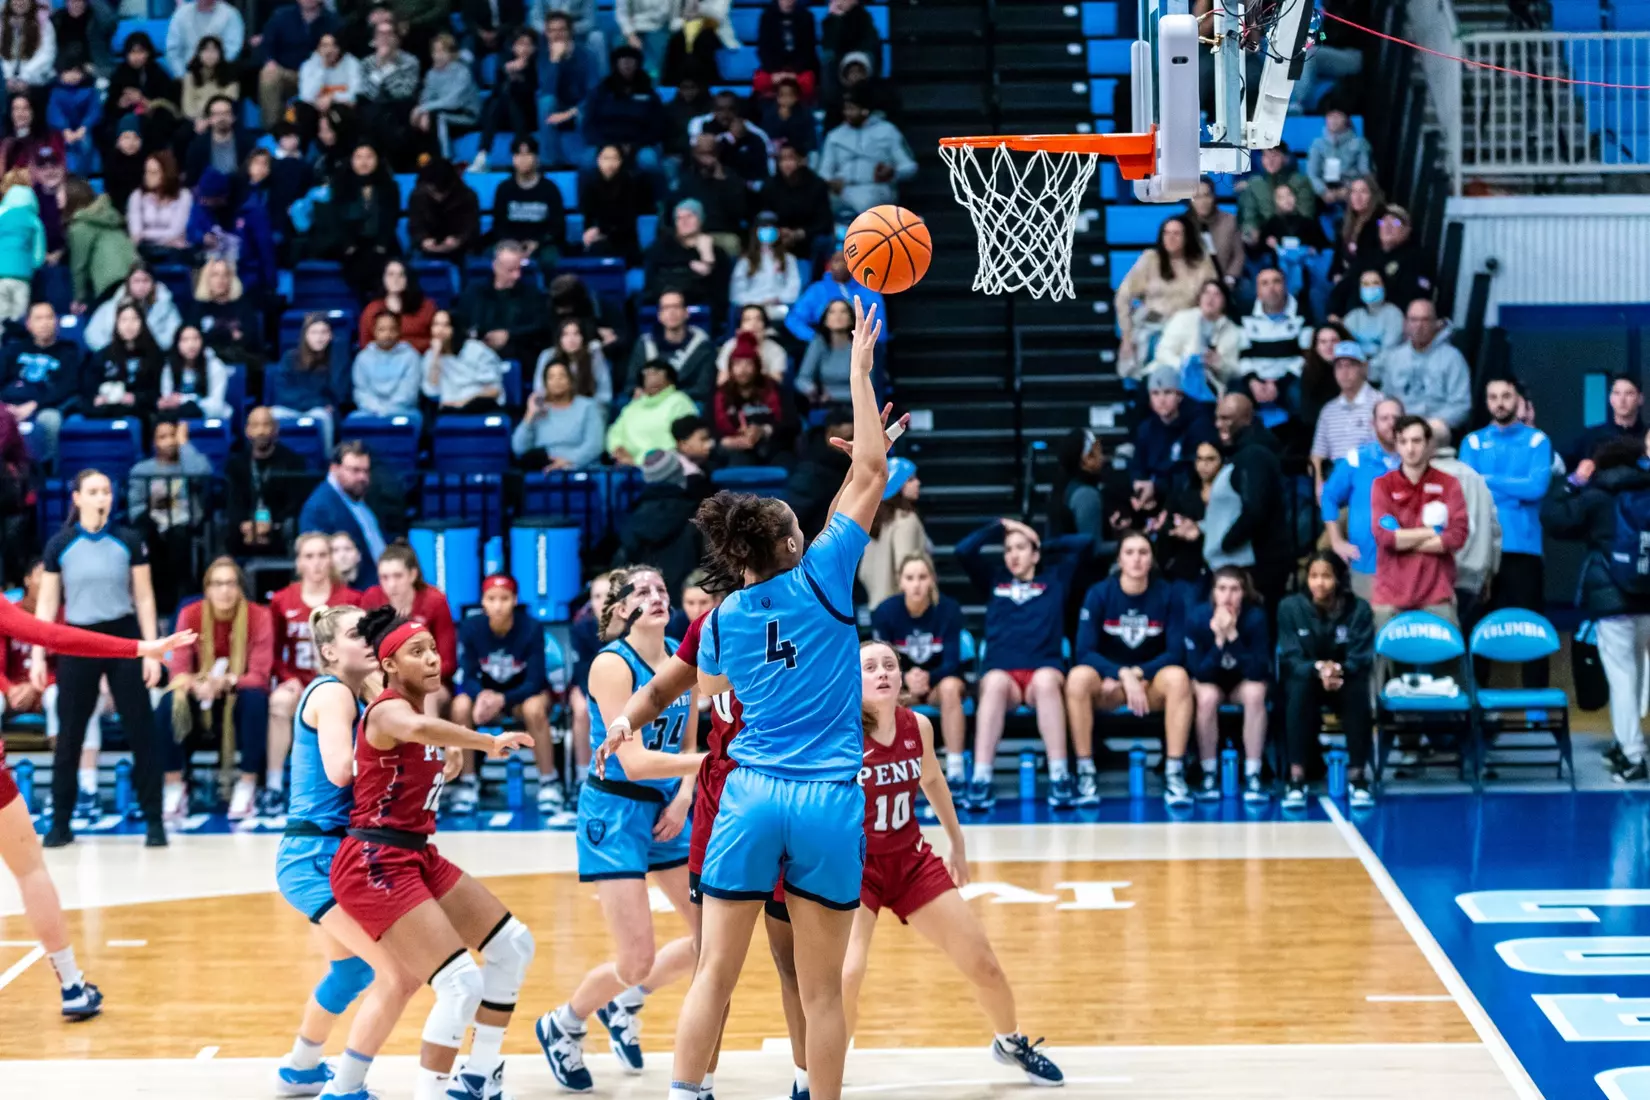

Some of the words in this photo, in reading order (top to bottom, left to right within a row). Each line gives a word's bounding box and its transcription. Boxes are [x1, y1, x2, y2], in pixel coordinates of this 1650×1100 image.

[765, 619, 798, 670] 4
[1387, 623, 1452, 641] COLUMBIA
[1482, 621, 1548, 640] COLUMBIA
[857, 757, 922, 788] PENN
[874, 791, 911, 832] 10
